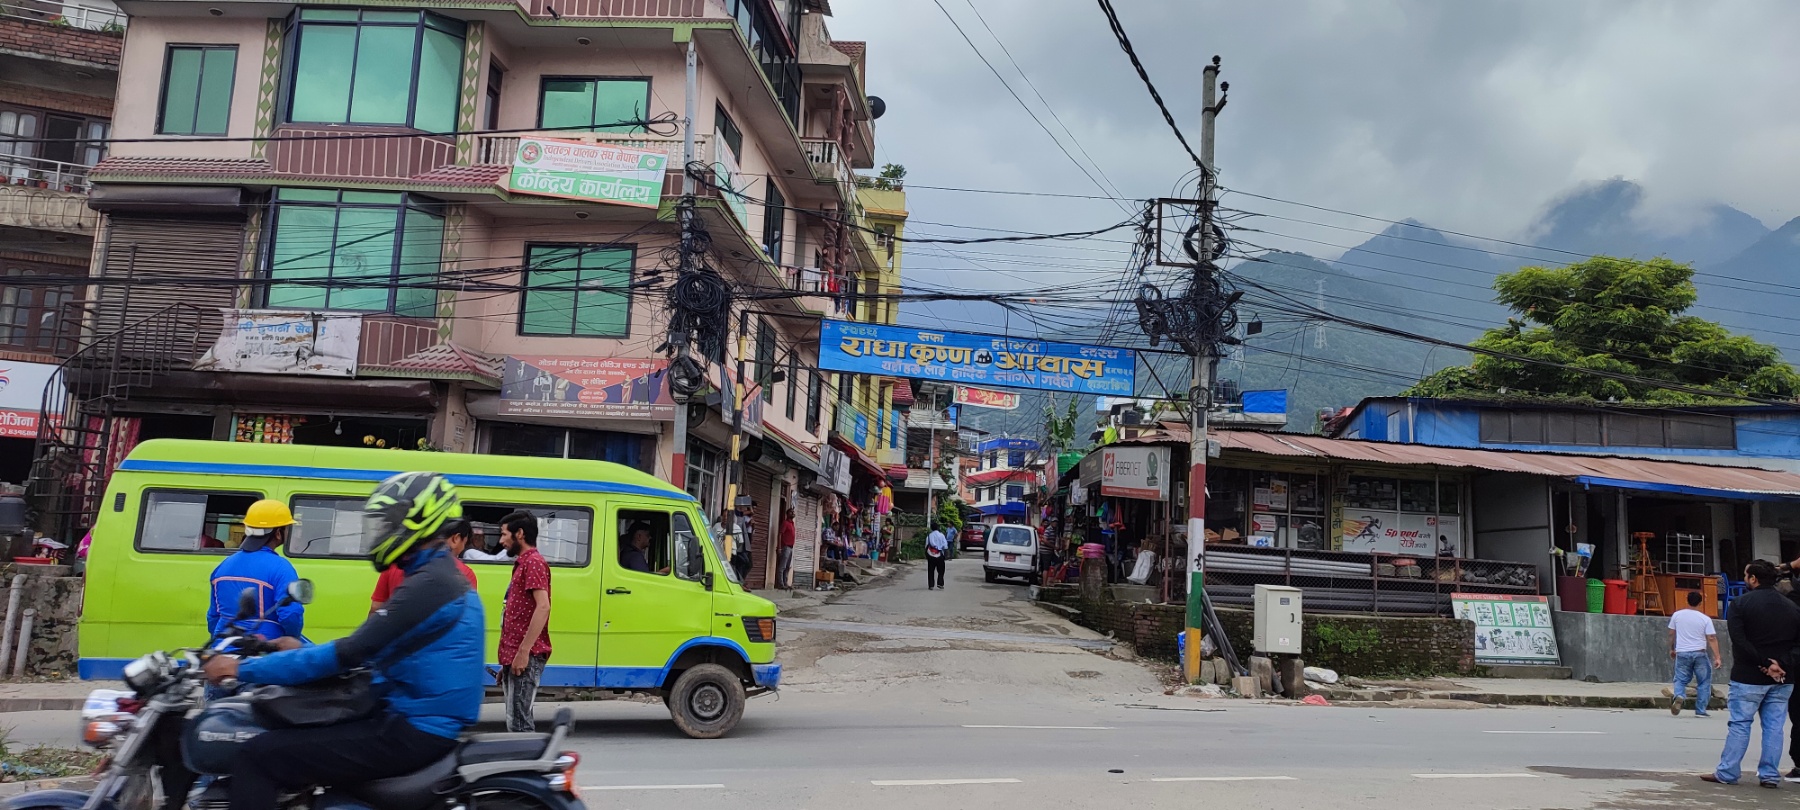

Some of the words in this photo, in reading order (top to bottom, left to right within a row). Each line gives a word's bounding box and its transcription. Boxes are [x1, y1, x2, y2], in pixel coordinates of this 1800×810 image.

[616, 149, 639, 164] नेपाल
[517, 167, 577, 194] केन्द्रिय
[579, 178, 652, 202] कार्यालय
[839, 336, 909, 358] राधा
[910, 342, 974, 367] कृष्ण
[994, 350, 1107, 380] आवास
[1115, 460, 1142, 477] FIBERNET
[1384, 528, 1419, 539] Speed
